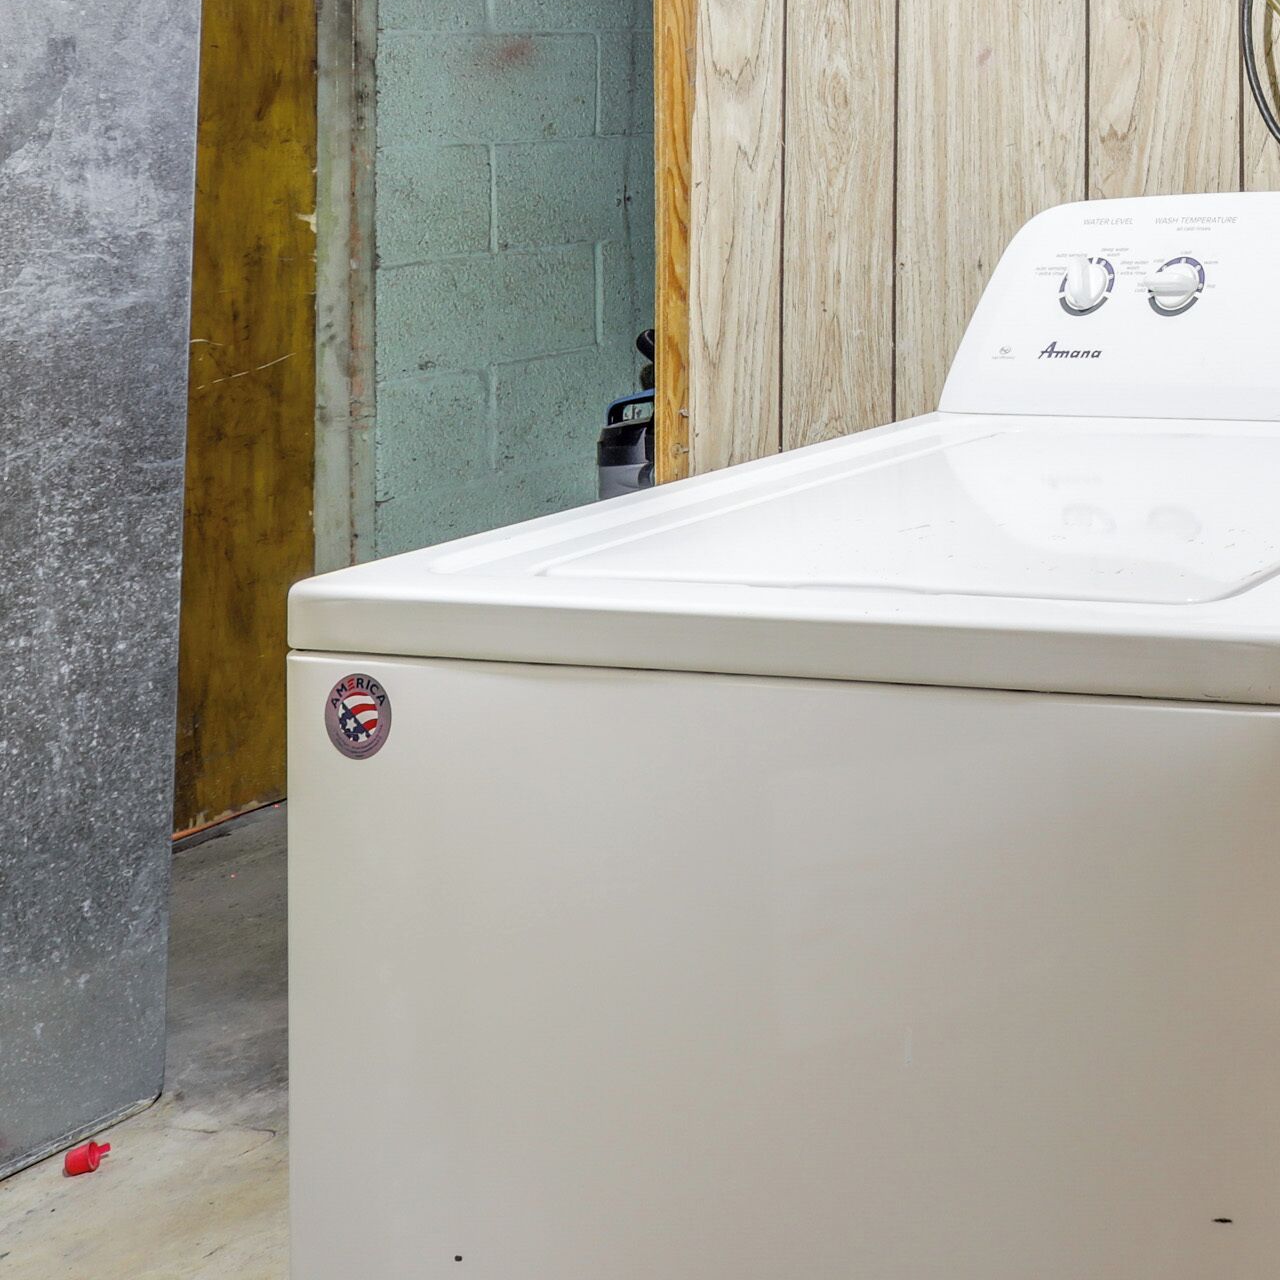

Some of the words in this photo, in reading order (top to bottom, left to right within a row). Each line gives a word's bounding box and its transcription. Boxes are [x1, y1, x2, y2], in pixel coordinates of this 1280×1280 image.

[1180, 216, 1239, 224] TEMPERATURE
[1037, 340, 1102, 360] Amana
[331, 677, 386, 709] AMERICA
